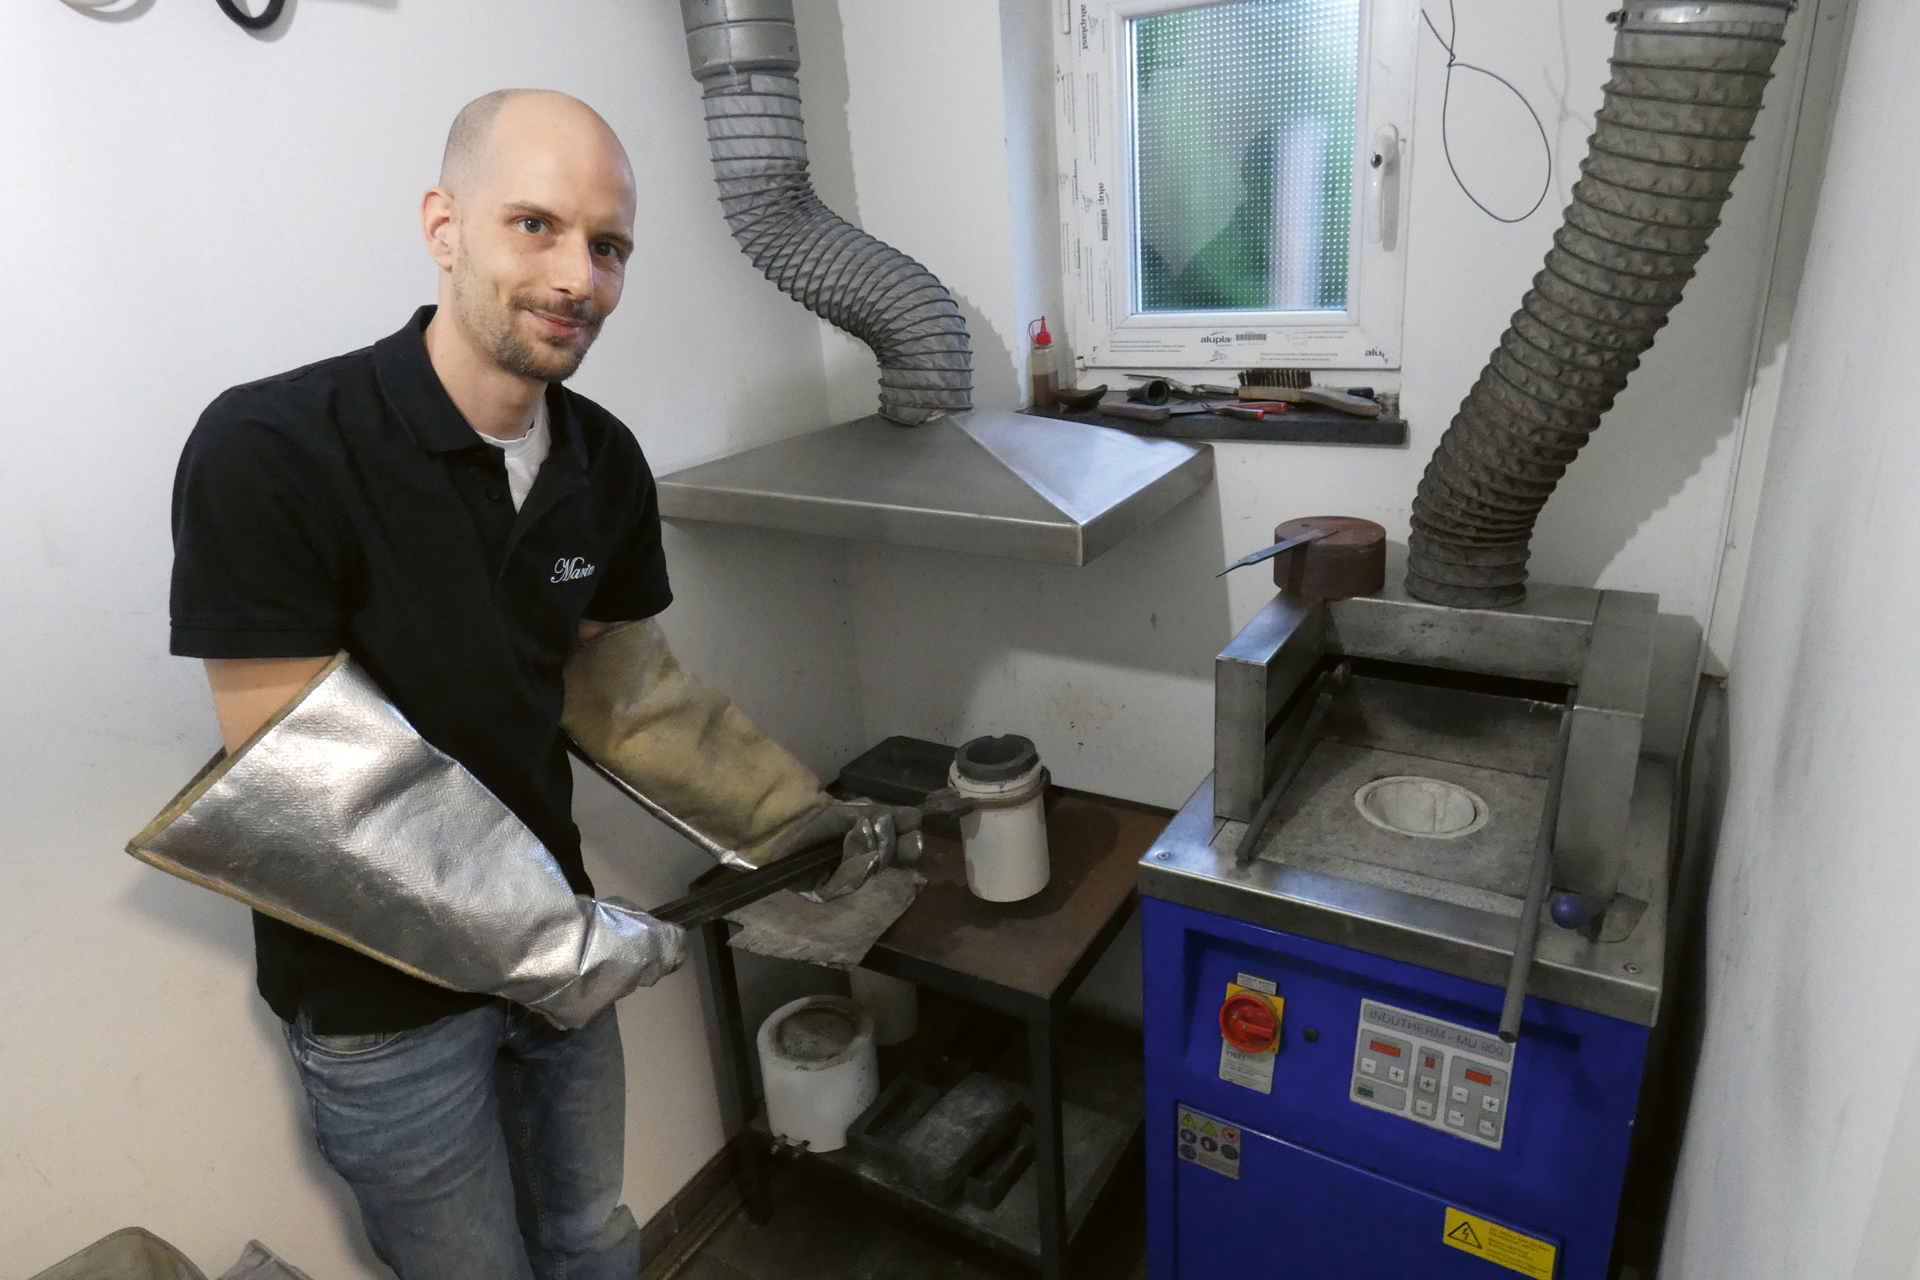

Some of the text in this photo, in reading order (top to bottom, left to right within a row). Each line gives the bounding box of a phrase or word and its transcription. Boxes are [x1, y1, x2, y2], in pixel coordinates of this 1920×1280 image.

[1080, 3, 1089, 50] aluplast
[1368, 1009, 1446, 1040] INDUTHERM
[1456, 1034, 1478, 1050] MU
